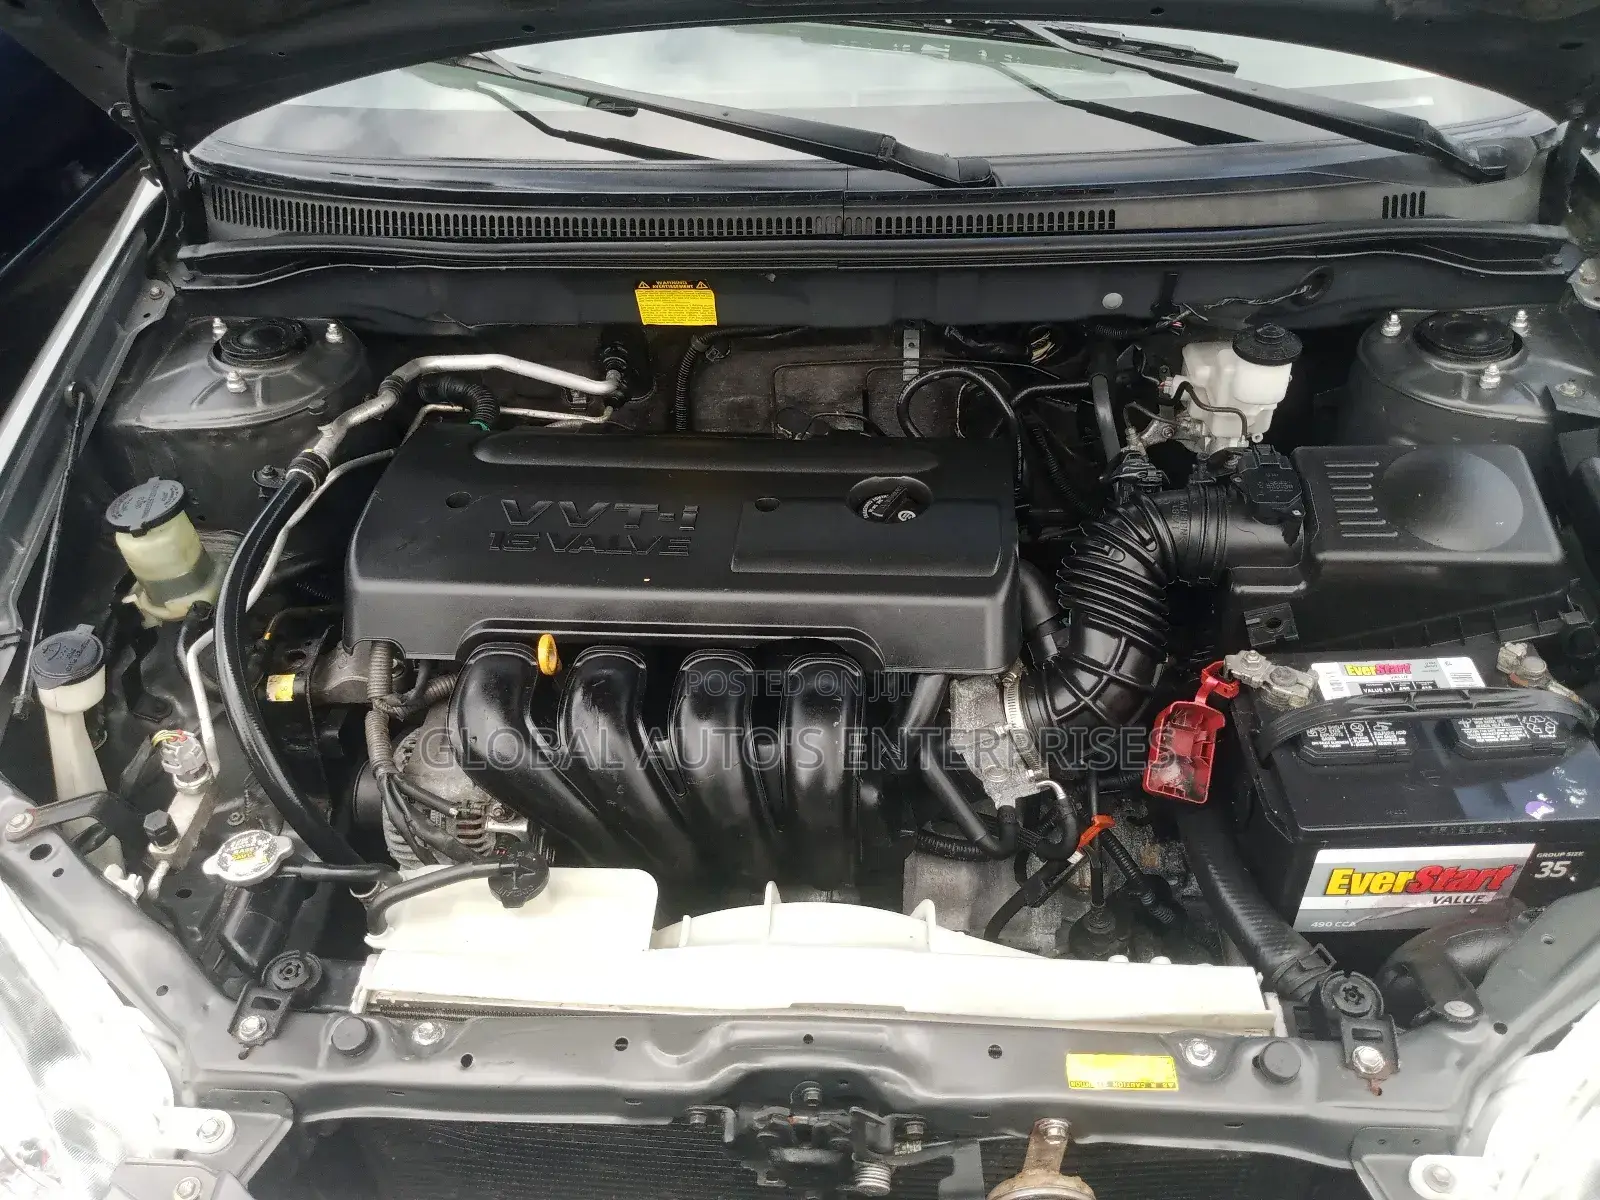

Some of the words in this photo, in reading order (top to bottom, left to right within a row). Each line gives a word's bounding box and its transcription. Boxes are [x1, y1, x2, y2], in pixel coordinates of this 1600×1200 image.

[489, 532, 540, 552] 16
[546, 532, 692, 556] VALVE
[1344, 663, 1412, 677] EverStart
[1534, 860, 1572, 878] 35
[1324, 864, 1517, 896] EverStart
[1431, 894, 1486, 905] VALUE
